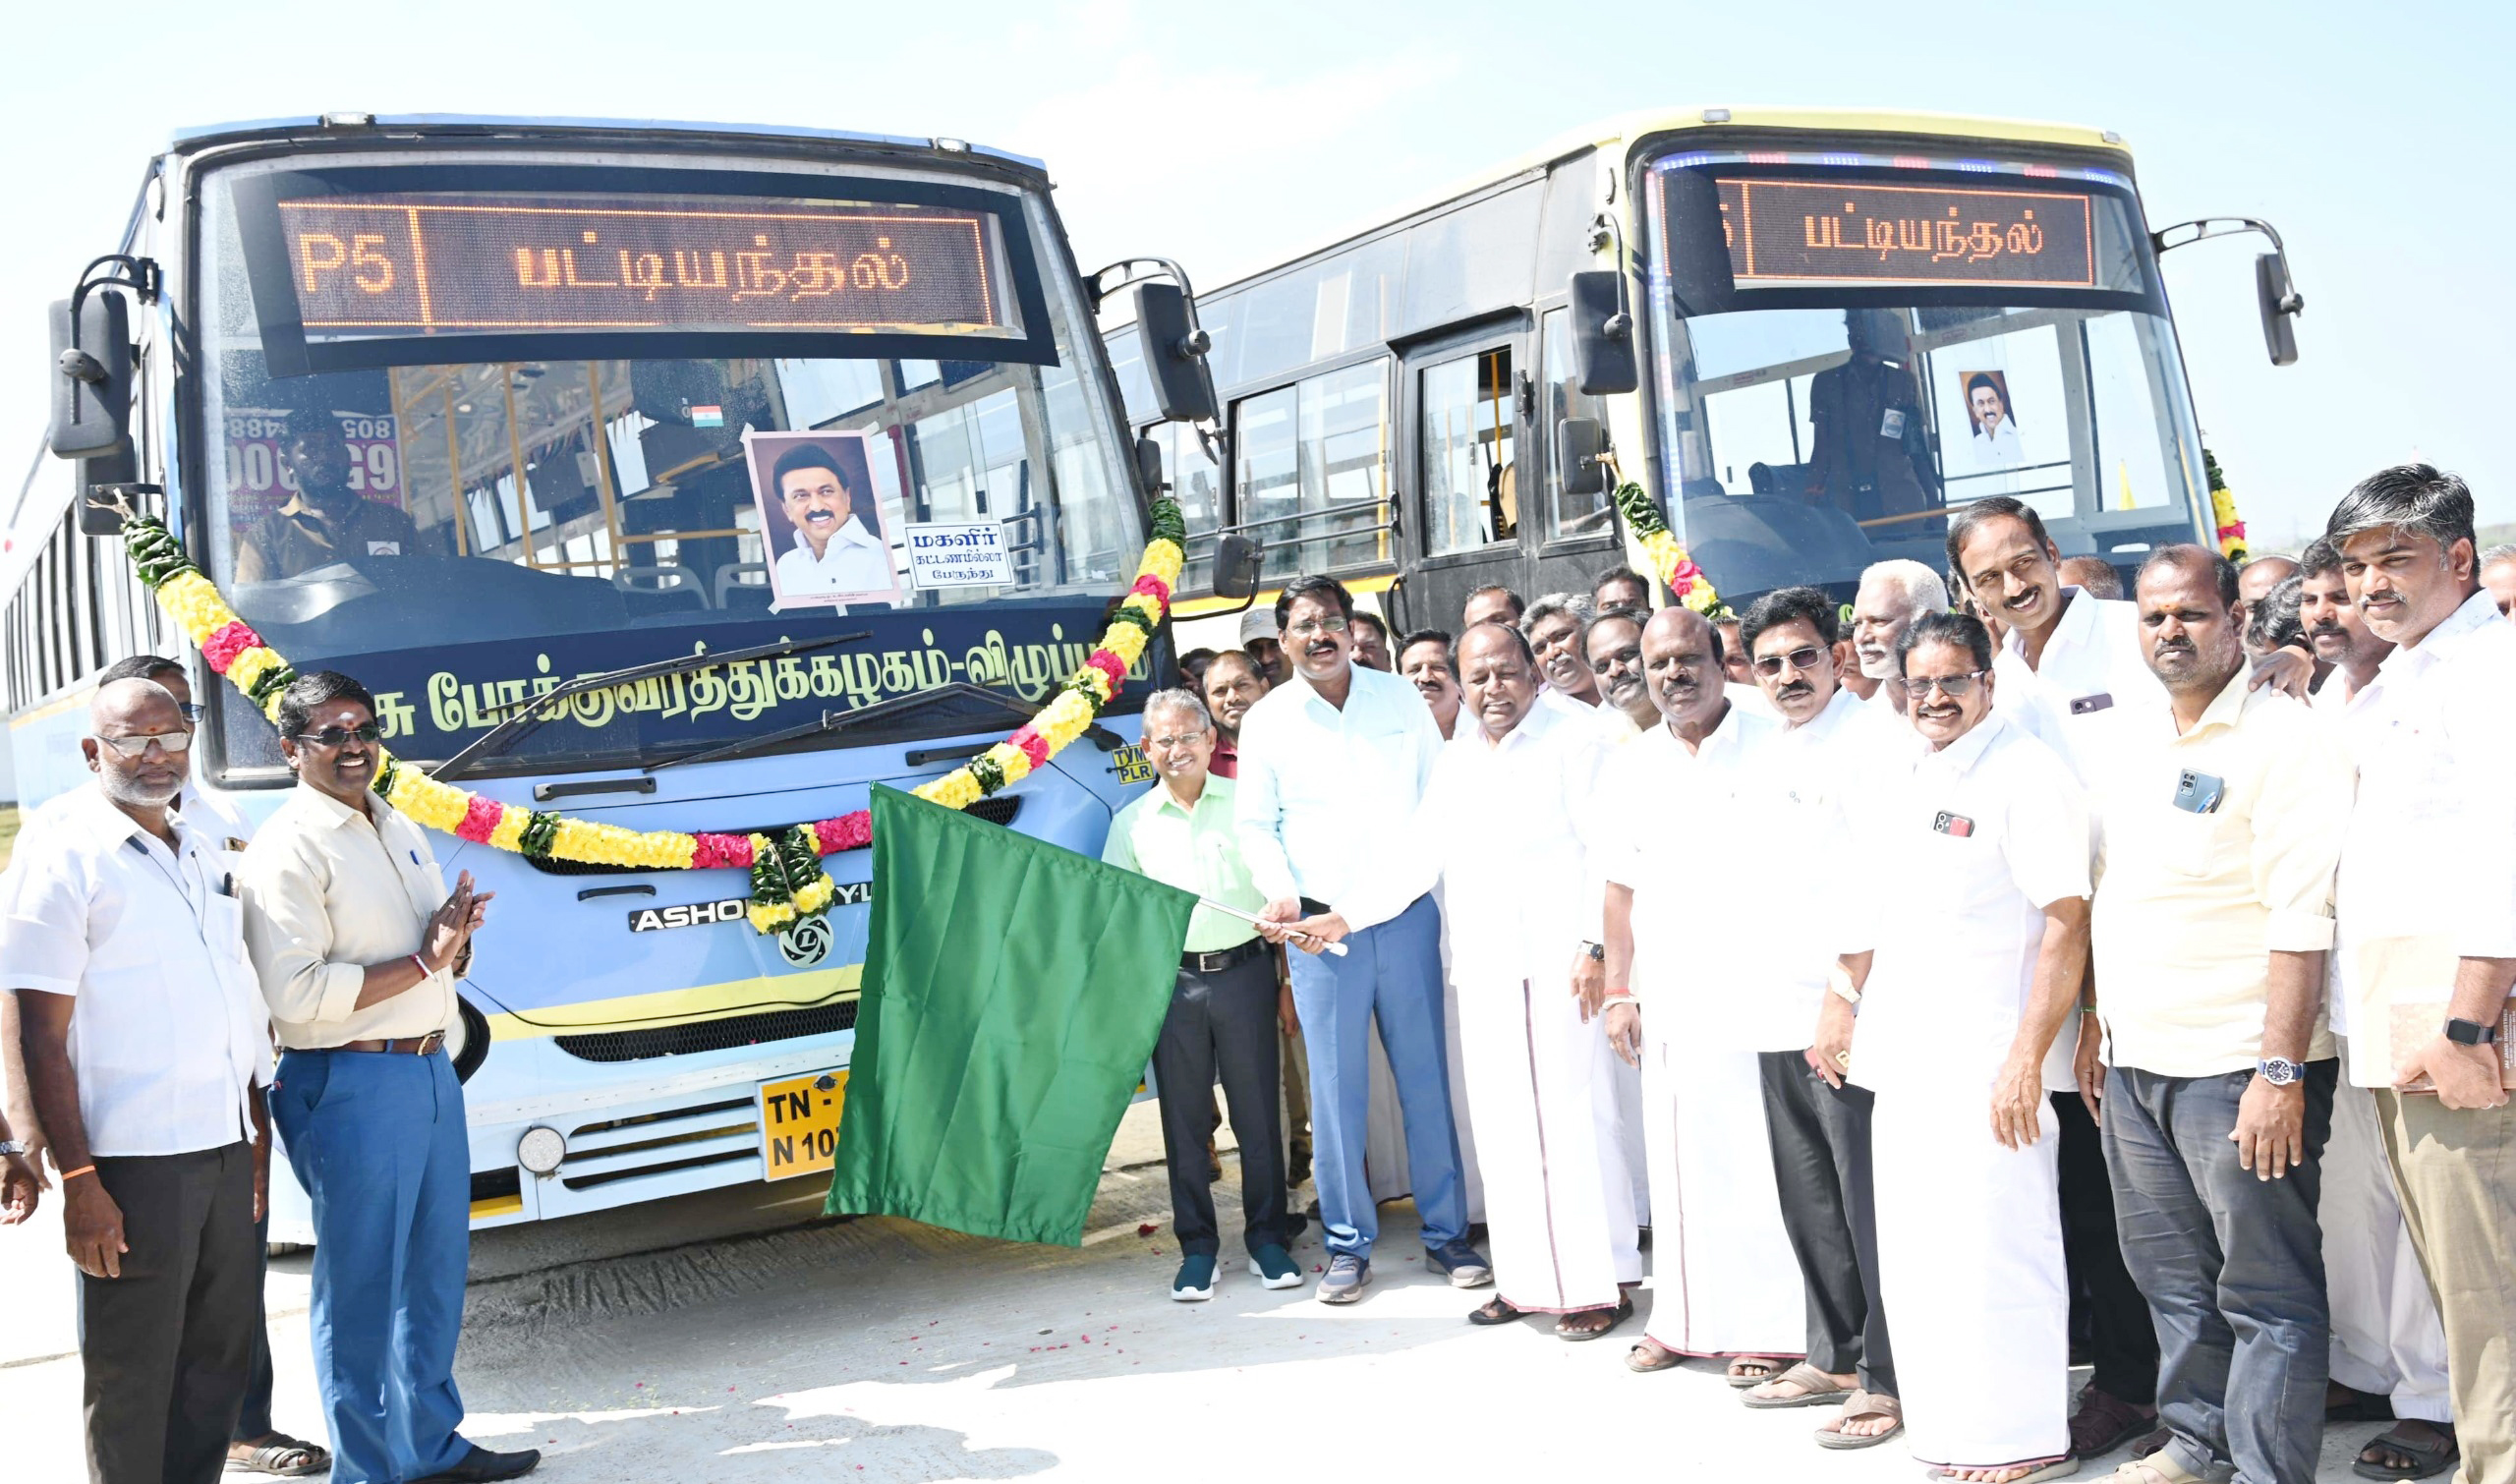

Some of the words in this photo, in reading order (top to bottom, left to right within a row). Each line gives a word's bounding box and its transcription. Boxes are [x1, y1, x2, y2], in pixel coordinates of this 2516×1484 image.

[1804, 201, 2044, 263] பட்டியந்தல்
[299, 233, 394, 293] P5
[515, 230, 910, 302] பட்டியந்தல்
[913, 527, 998, 547] மகளிர்
[915, 548, 1002, 565] கட்டணமில்லா
[932, 567, 994, 581] பேருந்து
[374, 691, 416, 739] சு
[1120, 766, 1151, 781] PLR
[636, 898, 750, 932] ASHO
[768, 1089, 811, 1123] TN
[772, 1135, 794, 1166] N
[802, 1125, 839, 1160] 10
